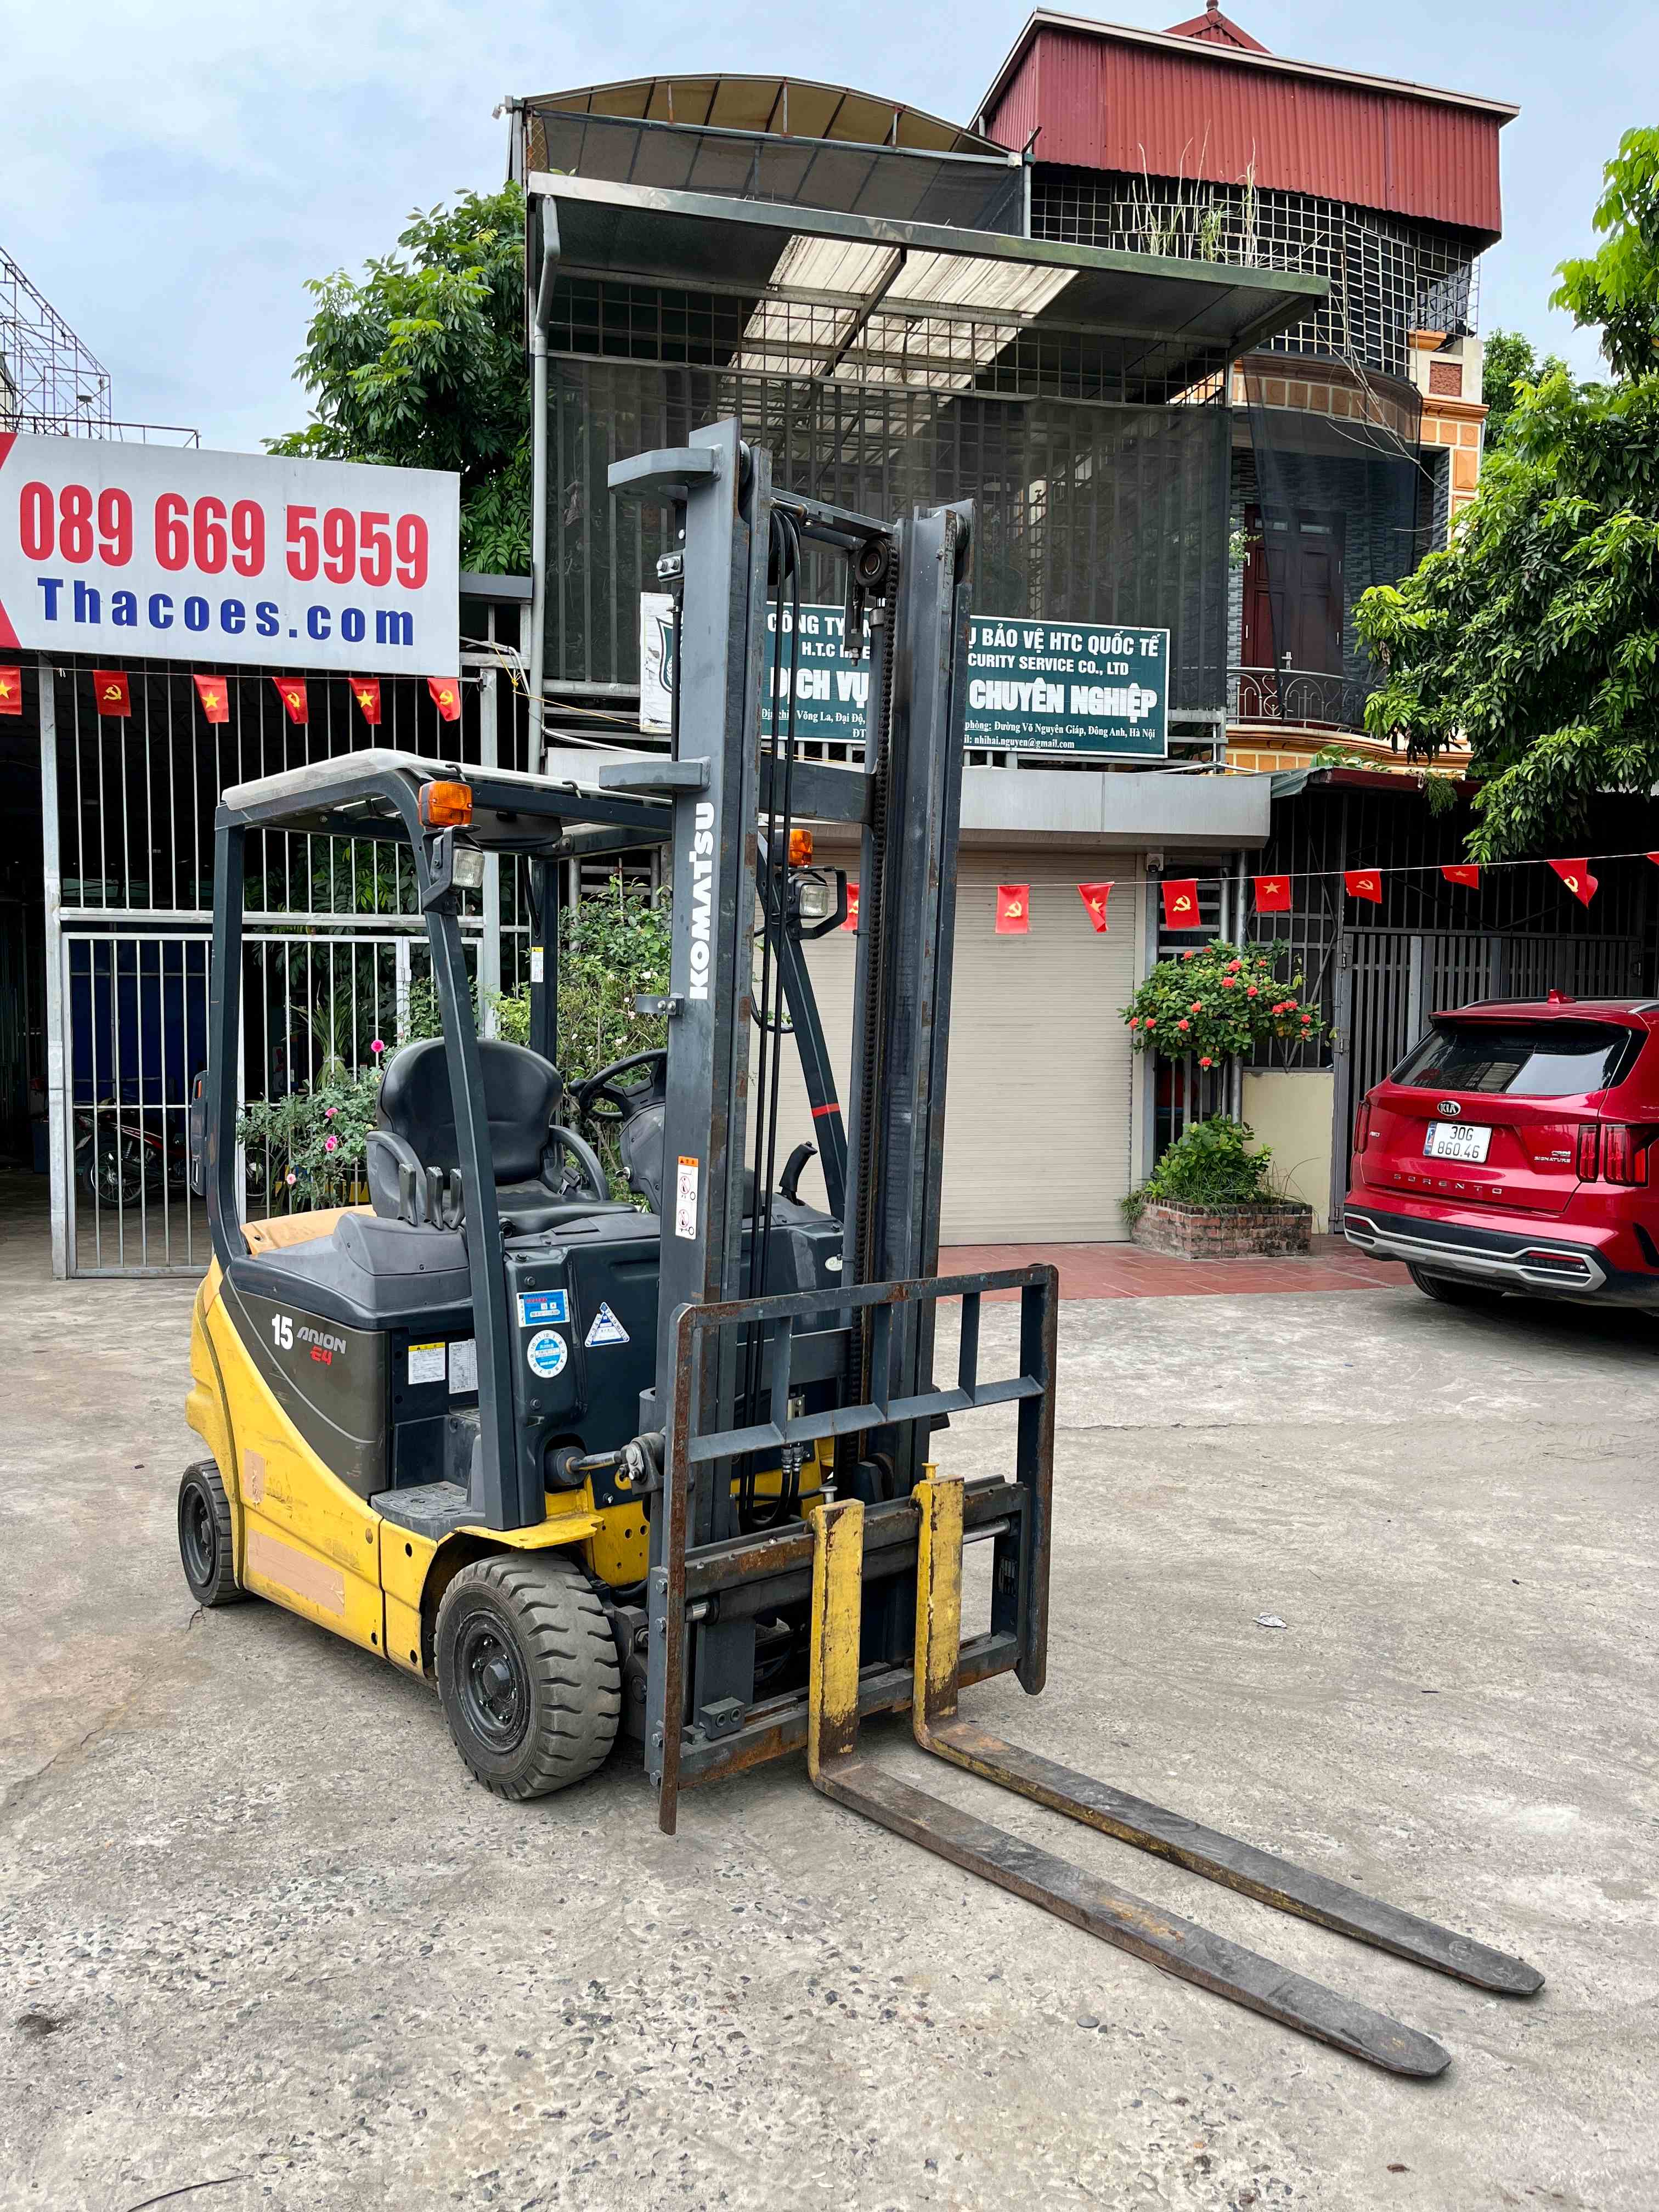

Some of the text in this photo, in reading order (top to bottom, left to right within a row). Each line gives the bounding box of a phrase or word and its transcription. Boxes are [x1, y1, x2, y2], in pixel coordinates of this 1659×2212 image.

[20, 482, 428, 589] 089 669 5959
[37, 577, 414, 646] Thacoes.com
[768, 610, 819, 635] CÔNG
[824, 617, 844, 636] TY
[802, 641, 836, 657] H.T.C
[982, 623, 1018, 648] BẢO
[1023, 628, 1045, 653] VỆ
[1049, 632, 1083, 652] HTC
[1088, 630, 1135, 655] QUỐC
[1139, 634, 1161, 657] TẾ
[968, 653, 1129, 675] CURITY SERVICE CO., LTD
[836, 670, 870, 708] VỤ
[969, 677, 1158, 723] CHUYÊN NGHIỆP
[797, 710, 819, 723] Võng
[820, 711, 833, 723] La,
[835, 713, 850, 724] Đại
[851, 713, 866, 725] Độ,
[964, 719, 1155, 740] phòng: Đường Võ Nguyên Giáp, Đông Anh, Hà Nội
[964, 735, 1075, 748] il: nhihai.nguyen@gmail.com
[689, 802, 714, 1000] KOMATSU
[1440, 1103, 1457, 1113] KIA
[1449, 1126, 1474, 1141] 30G
[1437, 1141, 1480, 1159] 860.46
[1393, 1173, 1502, 1194] SORENTO
[272, 1313, 347, 1355] 15 ARION
